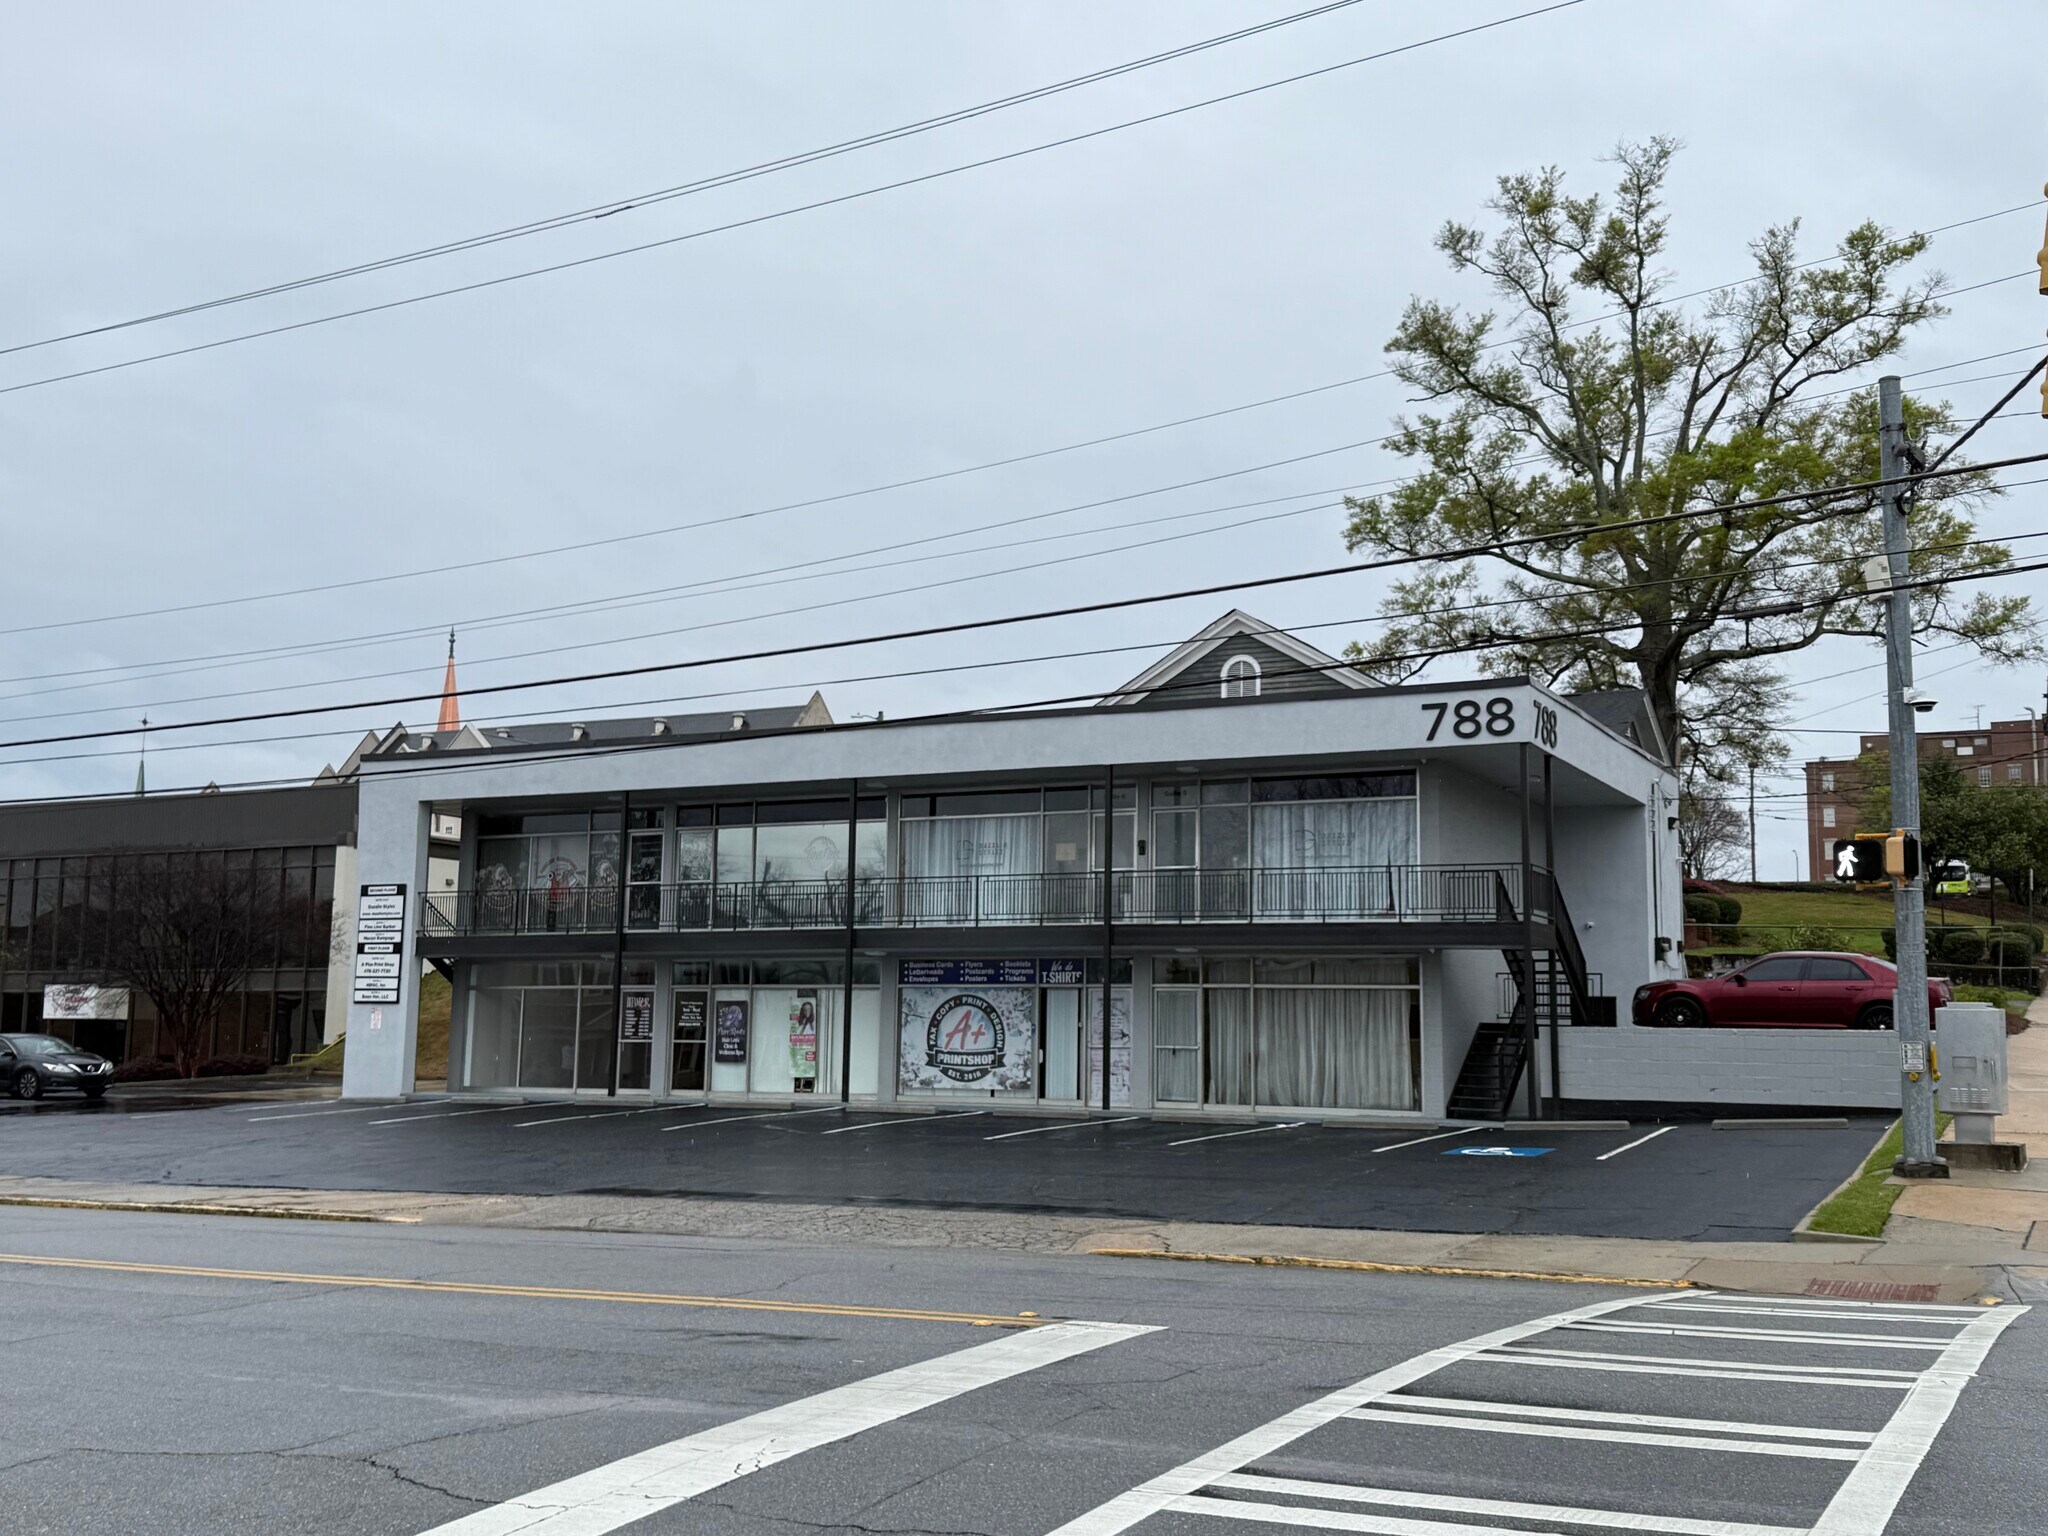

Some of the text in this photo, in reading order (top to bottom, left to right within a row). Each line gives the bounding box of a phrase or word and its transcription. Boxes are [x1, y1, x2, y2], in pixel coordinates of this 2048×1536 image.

[1421, 697, 1515, 741] 788
[1533, 700, 1557, 749] 788
[929, 996, 1004, 1048] FAX COPY PRINT DESIGN
[944, 1009, 986, 1051] A+
[937, 1053, 995, 1065] PRINTSHOP
[948, 1069, 962, 1080] EST.
